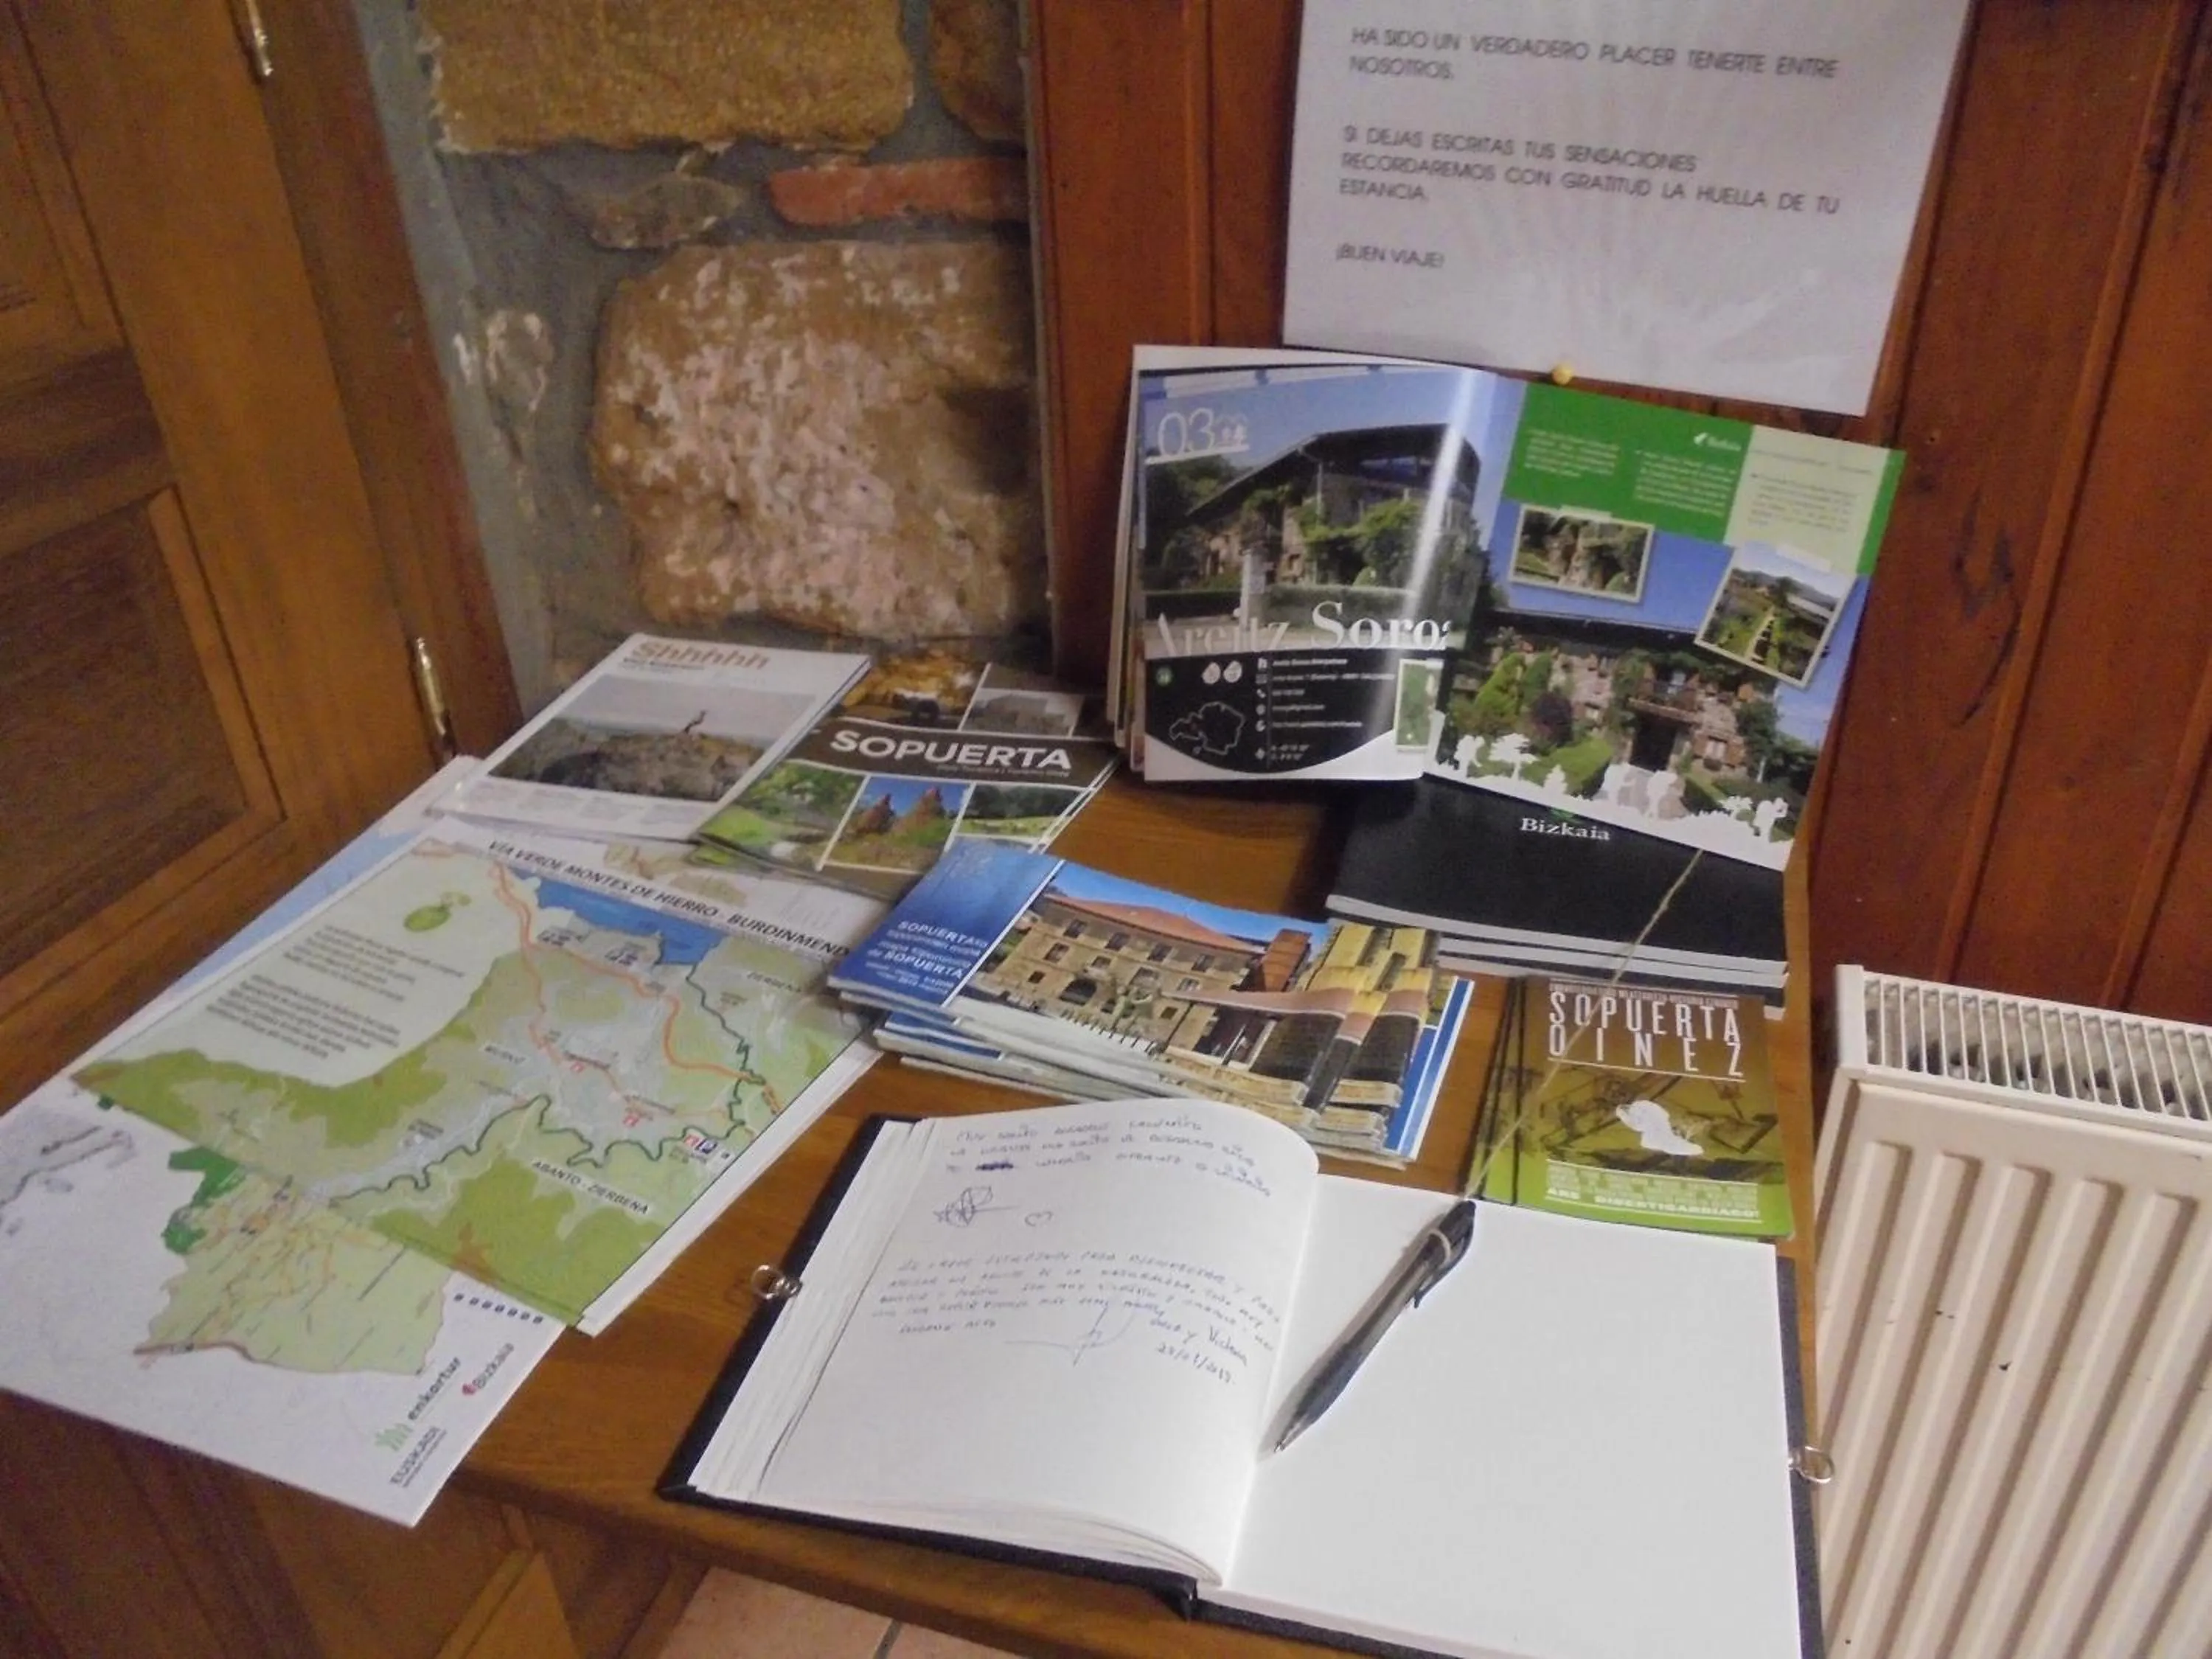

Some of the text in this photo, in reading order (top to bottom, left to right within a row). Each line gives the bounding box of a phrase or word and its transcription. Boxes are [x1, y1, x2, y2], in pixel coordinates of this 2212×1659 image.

[1349, 55, 1454, 80] NOSOTROS.
[1352, 27, 1840, 78] HA SIDO UN VERDADERO PLACER TENERTE ENTRE
[1366, 127, 1423, 148] DEJAS
[1431, 133, 1514, 156] ESCRITAS
[1524, 139, 1557, 160] TUS
[1565, 144, 1697, 172] SENSACIONES
[1340, 151, 1840, 215] RECORDAREMOS CON GRATITUD LA HUELLA DE TU
[1158, 407, 1217, 456] 03
[830, 729, 1073, 770] SOPUERTA
[1520, 816, 1612, 841] Bizkaia
[515, 847, 563, 871] VERDE
[563, 865, 629, 891] MONTES
[630, 883, 656, 899] DE
[653, 889, 720, 917] HIERRO
[1548, 990, 1741, 1043] SOPUERTA
[1548, 1023, 1745, 1077] OINEZ
